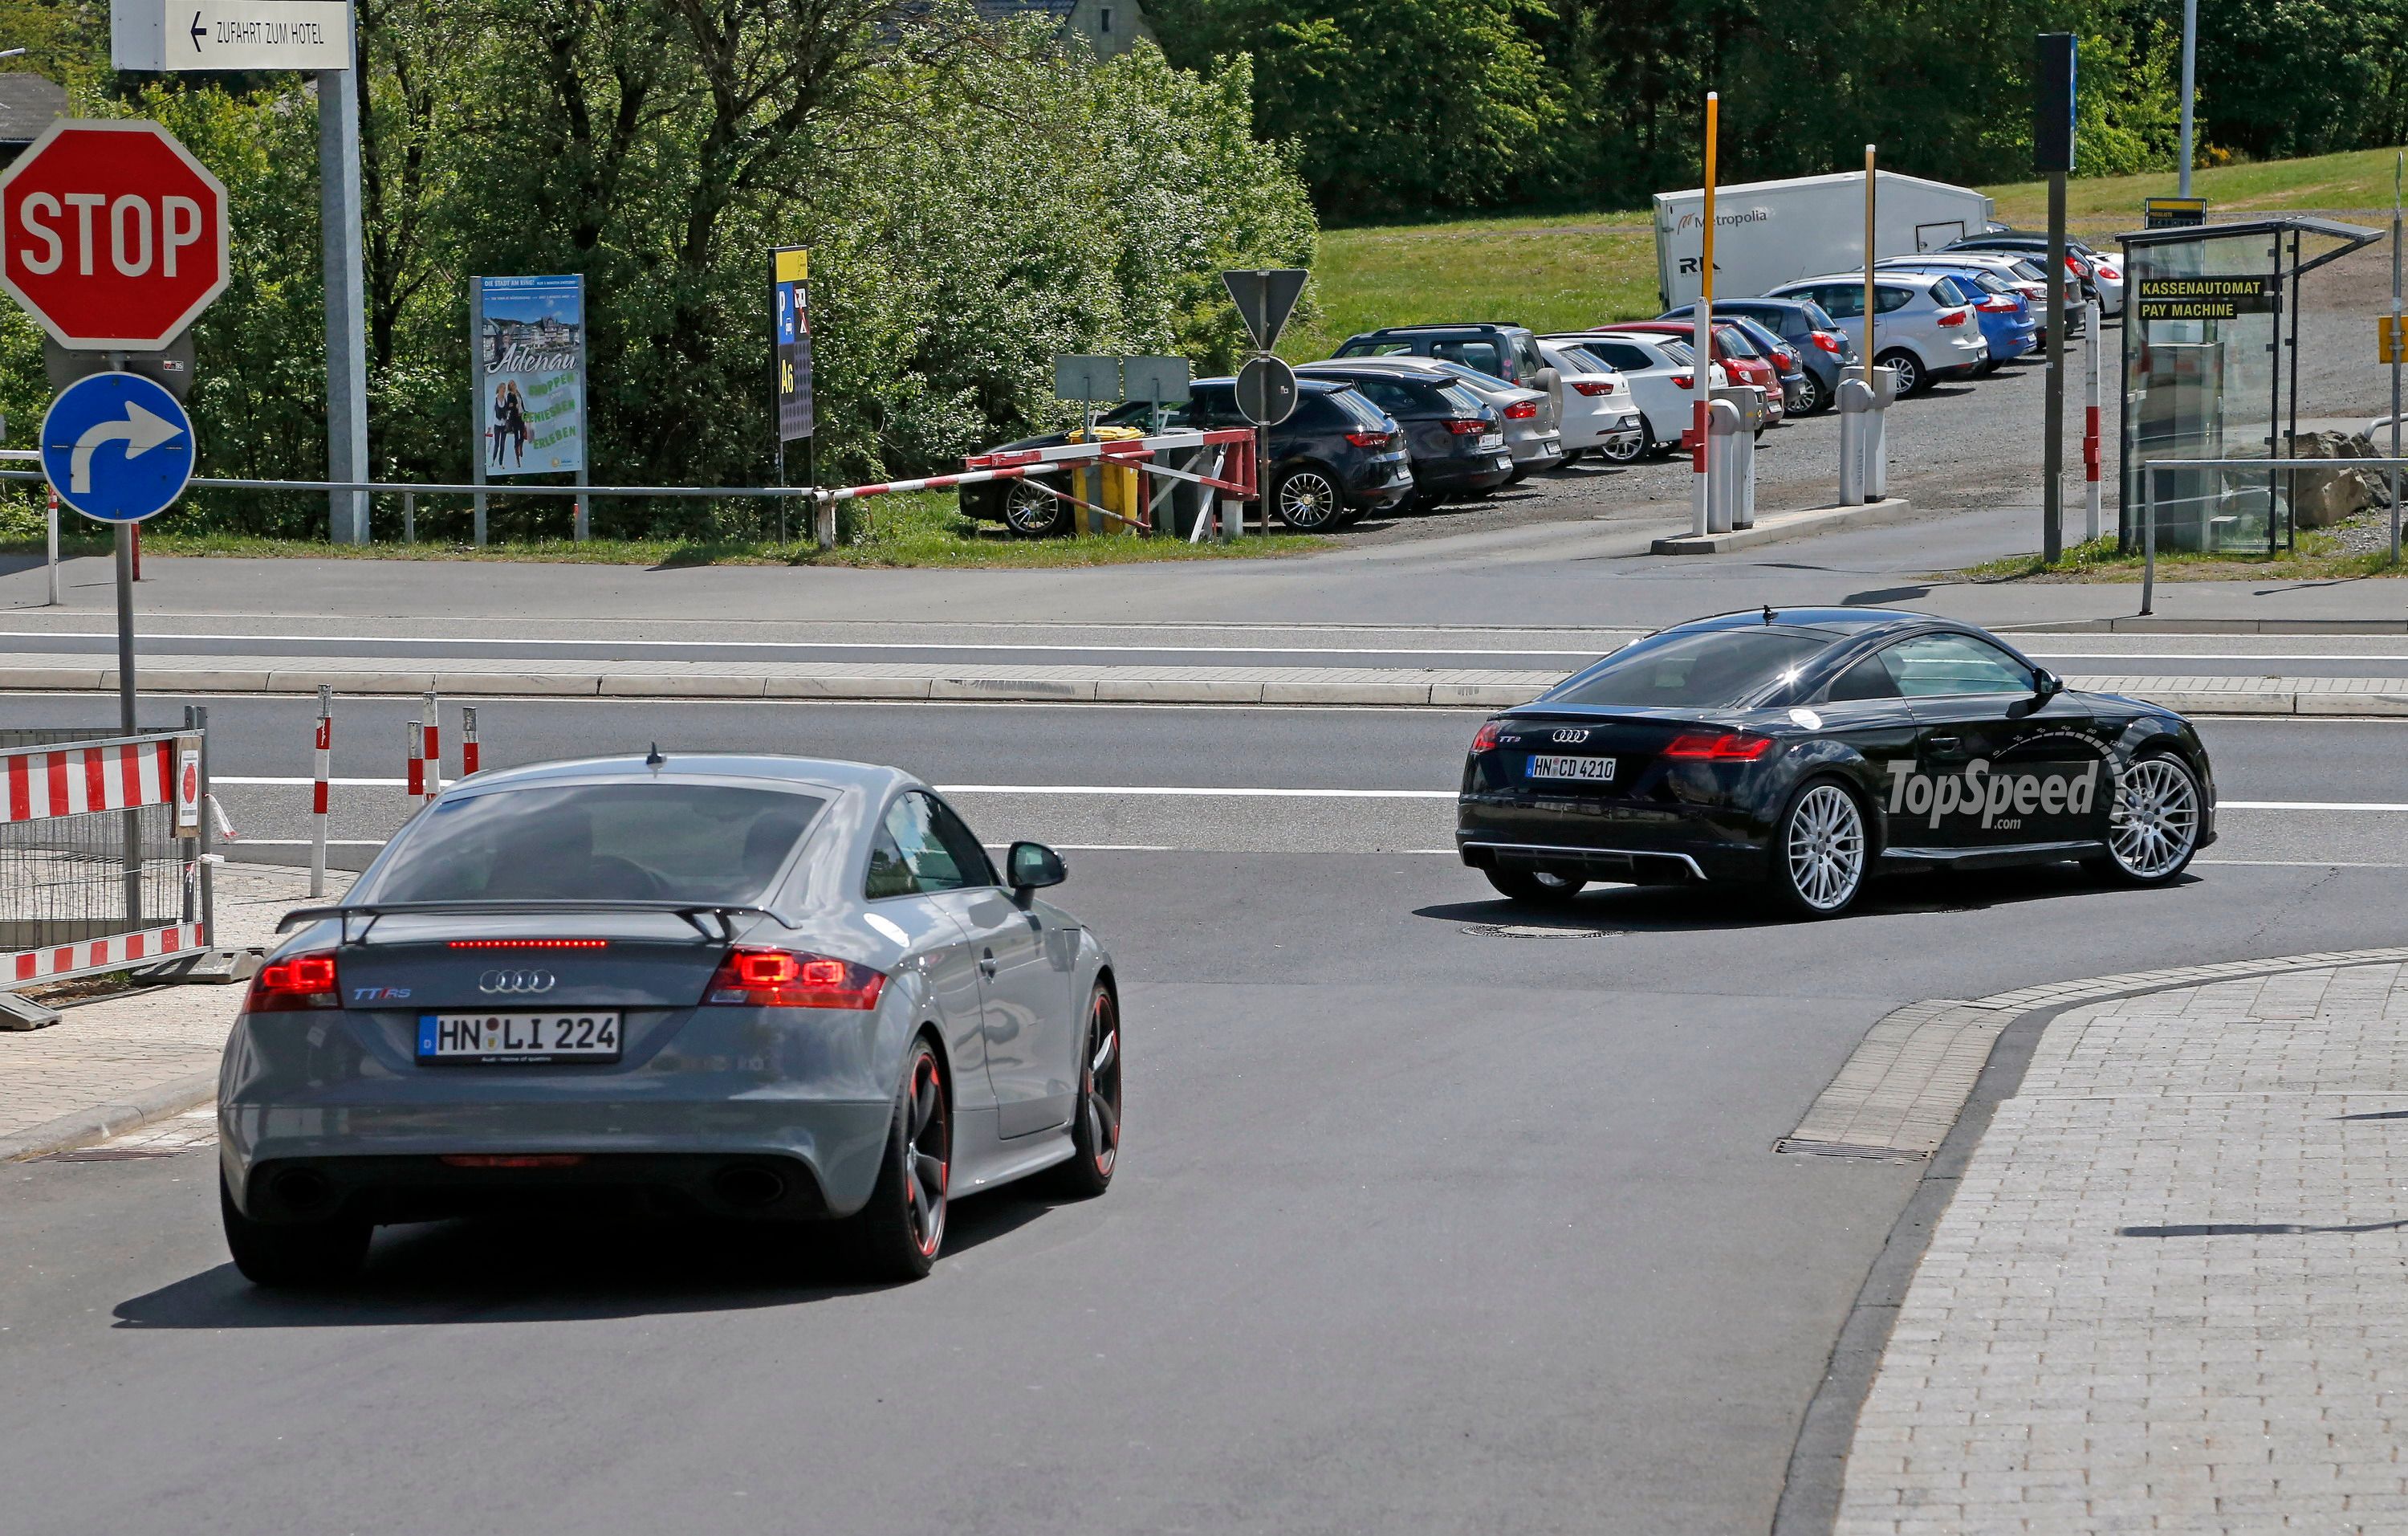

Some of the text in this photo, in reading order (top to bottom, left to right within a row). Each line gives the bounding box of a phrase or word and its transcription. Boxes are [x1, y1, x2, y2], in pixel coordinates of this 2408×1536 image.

[217, 22, 324, 44] ZUFAHRT ZUM HOTEL
[1694, 210, 1767, 228] Mtropolia
[20, 191, 202, 278] STOP
[2142, 282, 2261, 295] KASSENAUTOMAT
[779, 290, 786, 327] P
[2142, 304, 2234, 316] PAY MACHINE
[483, 342, 577, 374] Adenau
[781, 359, 794, 394] A6
[532, 426, 576, 450] ERLEBEN
[1534, 758, 1613, 778] HN CD 4210
[438, 1017, 616, 1051] HN LI 224
